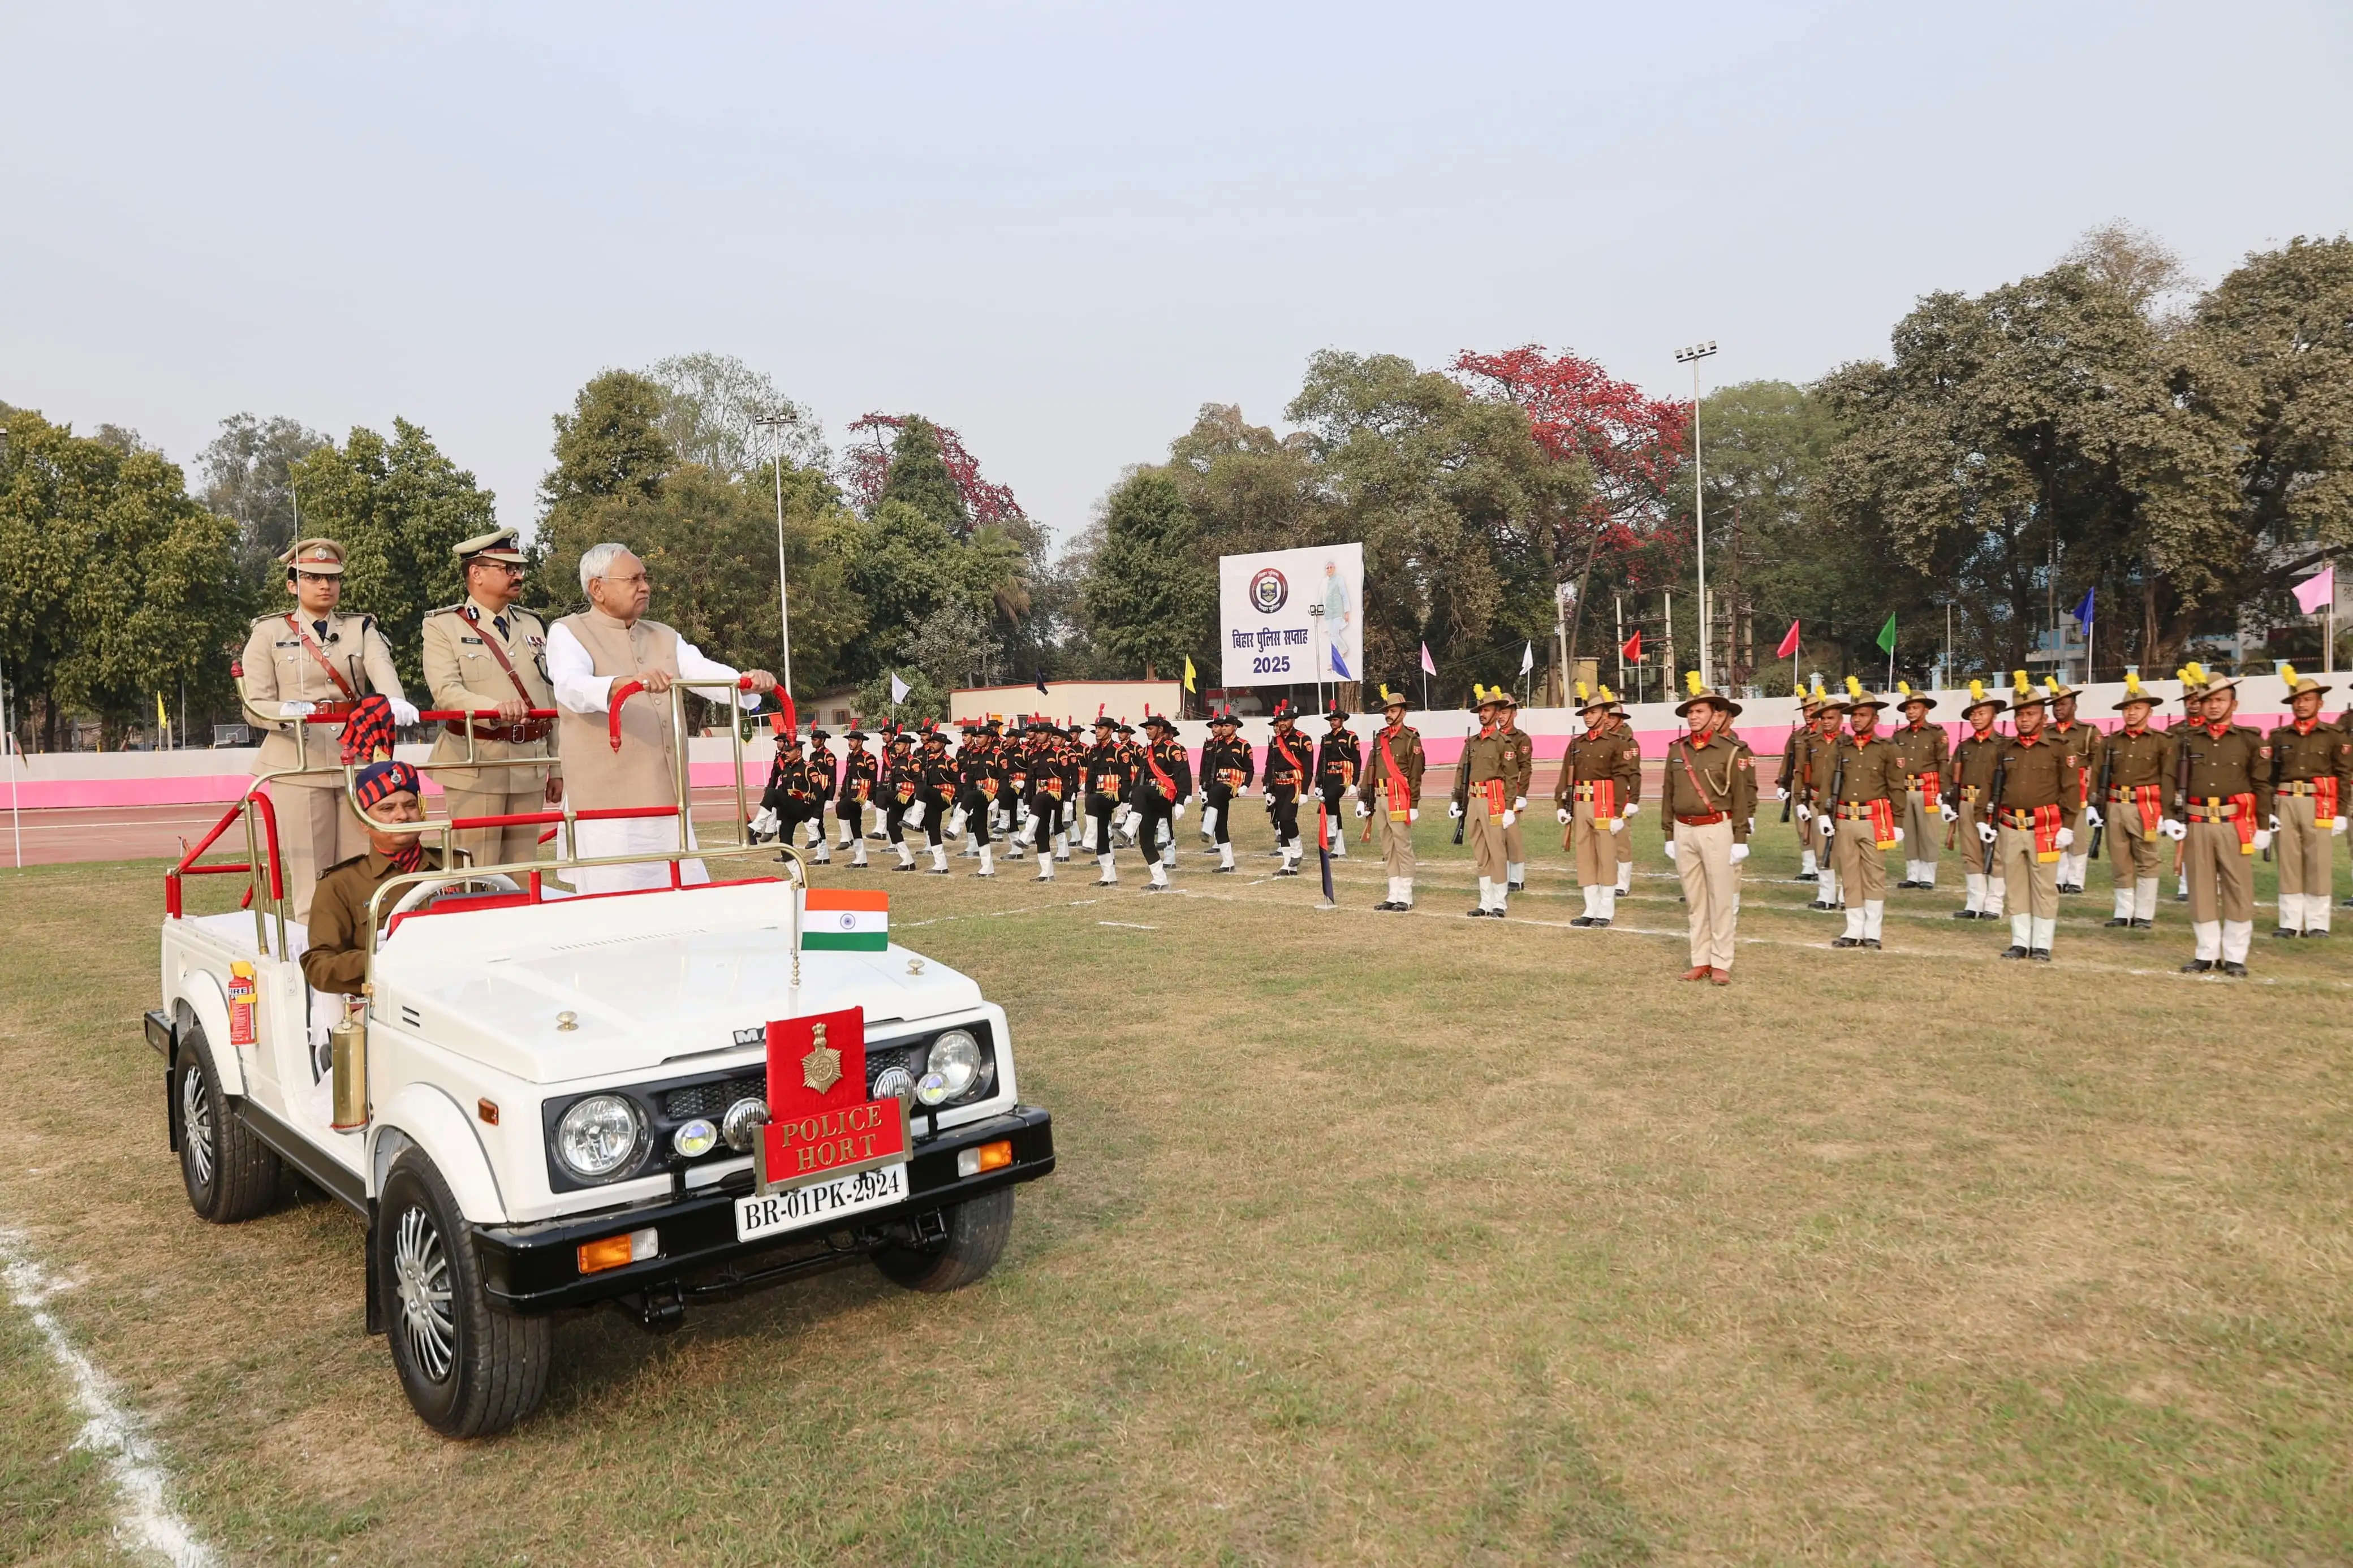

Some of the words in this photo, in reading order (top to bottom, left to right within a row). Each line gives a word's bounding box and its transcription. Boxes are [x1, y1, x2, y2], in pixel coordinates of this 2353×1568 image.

[1232, 629, 1254, 649] बिहार
[1256, 627, 1281, 653] पुलिस
[1283, 629, 1308, 645] सप्ताह
[1253, 656, 1290, 673] 2025
[734, 1027, 766, 1044] M
[782, 1105, 882, 1148] POLICE
[744, 1170, 899, 1231] BR-01PK-2924
